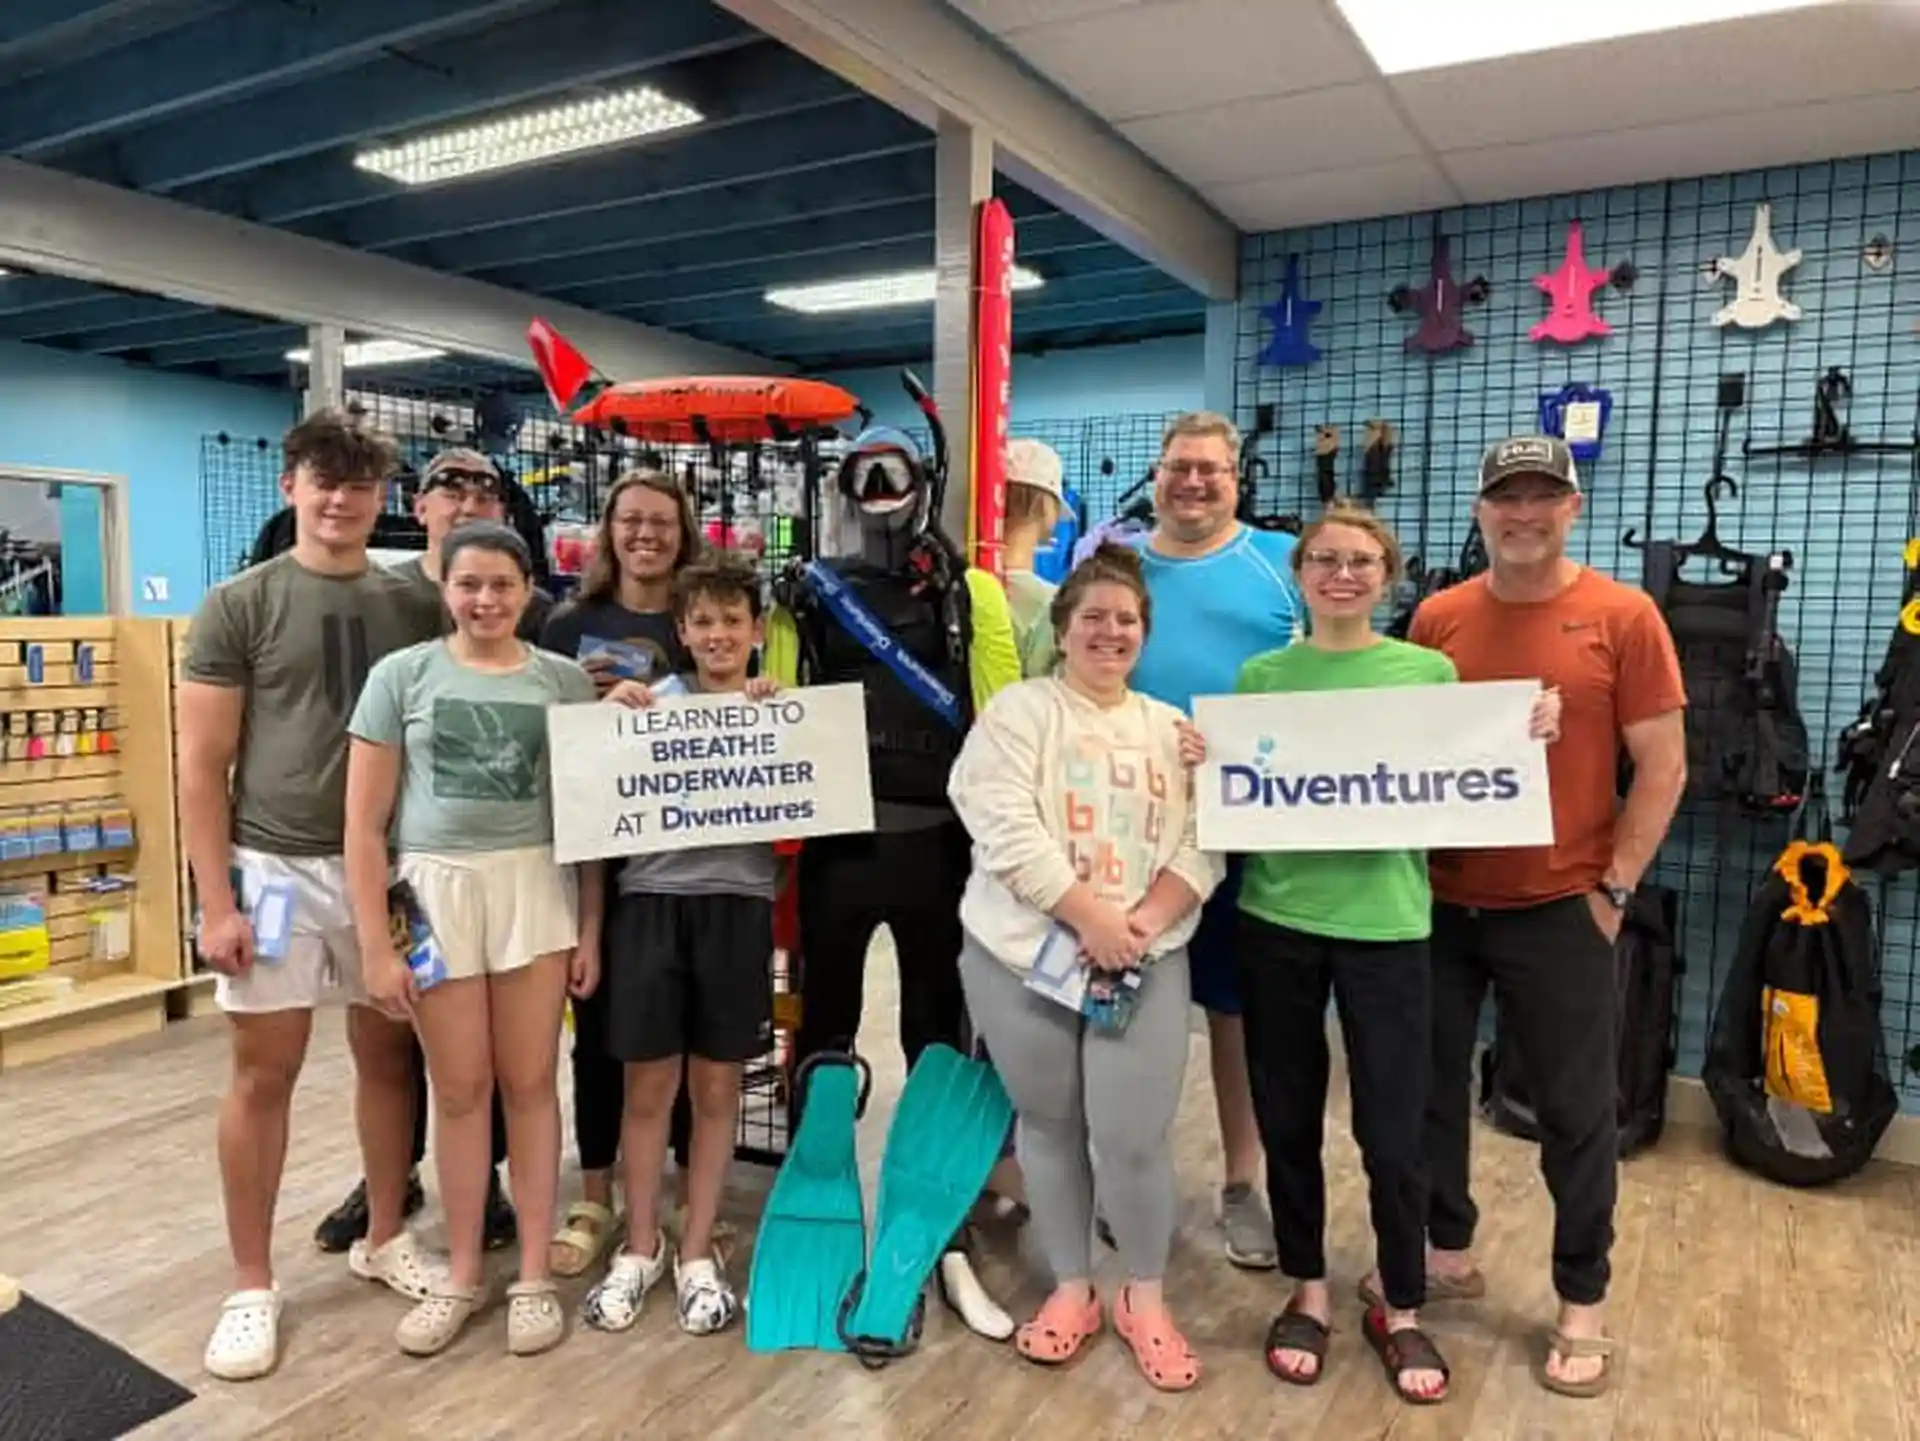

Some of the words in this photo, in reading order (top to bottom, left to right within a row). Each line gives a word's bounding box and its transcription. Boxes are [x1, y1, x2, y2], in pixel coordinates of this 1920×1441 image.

[617, 714, 623, 737] I
[632, 704, 761, 735] LEARNED
[765, 700, 805, 726] TO
[651, 733, 777, 763] BREATHE
[617, 760, 815, 799] UNDERWATER
[1219, 761, 1520, 807] Diventures
[613, 811, 646, 837] AT
[661, 799, 814, 831] Diventures
